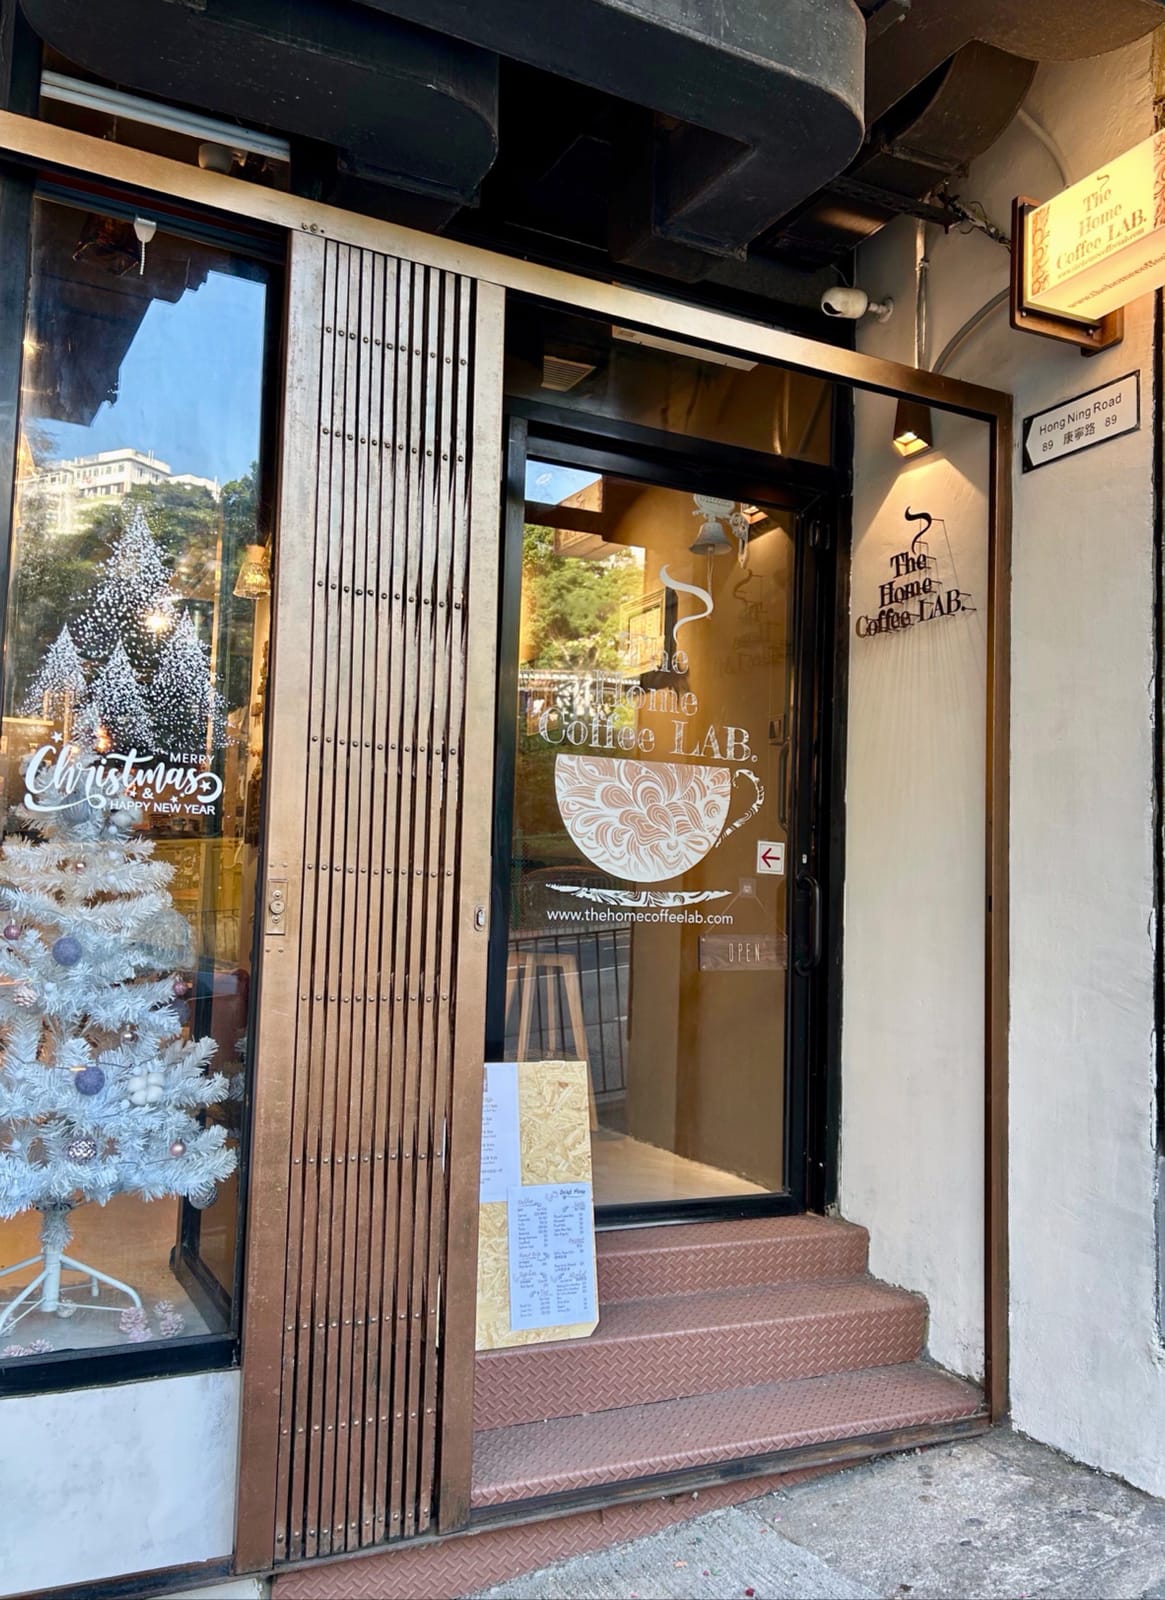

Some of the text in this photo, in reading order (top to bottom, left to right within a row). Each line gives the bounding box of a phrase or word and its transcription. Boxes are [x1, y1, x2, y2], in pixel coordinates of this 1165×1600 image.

[1082, 188, 1112, 213] The
[1079, 203, 1123, 238] Home
[1056, 208, 1148, 270] Coffee LAB.
[1039, 392, 1122, 436] Hong Ning Road
[1042, 439, 1054, 453] 89
[1104, 414, 1118, 428] 89
[890, 551, 927, 579] The
[878, 577, 933, 609] Home
[855, 588, 966, 639] Coffee LAB.
[591, 668, 699, 717] Home
[537, 706, 759, 763] Coffee LAB.
[169, 752, 215, 765] MERRY
[24, 744, 223, 812] Christmas
[142, 787, 154, 800] &
[109, 800, 216, 816] HAPPY NEW YEAR
[546, 907, 734, 925] www.thehomecoffeelab.com
[728, 942, 761, 963] OPEN
